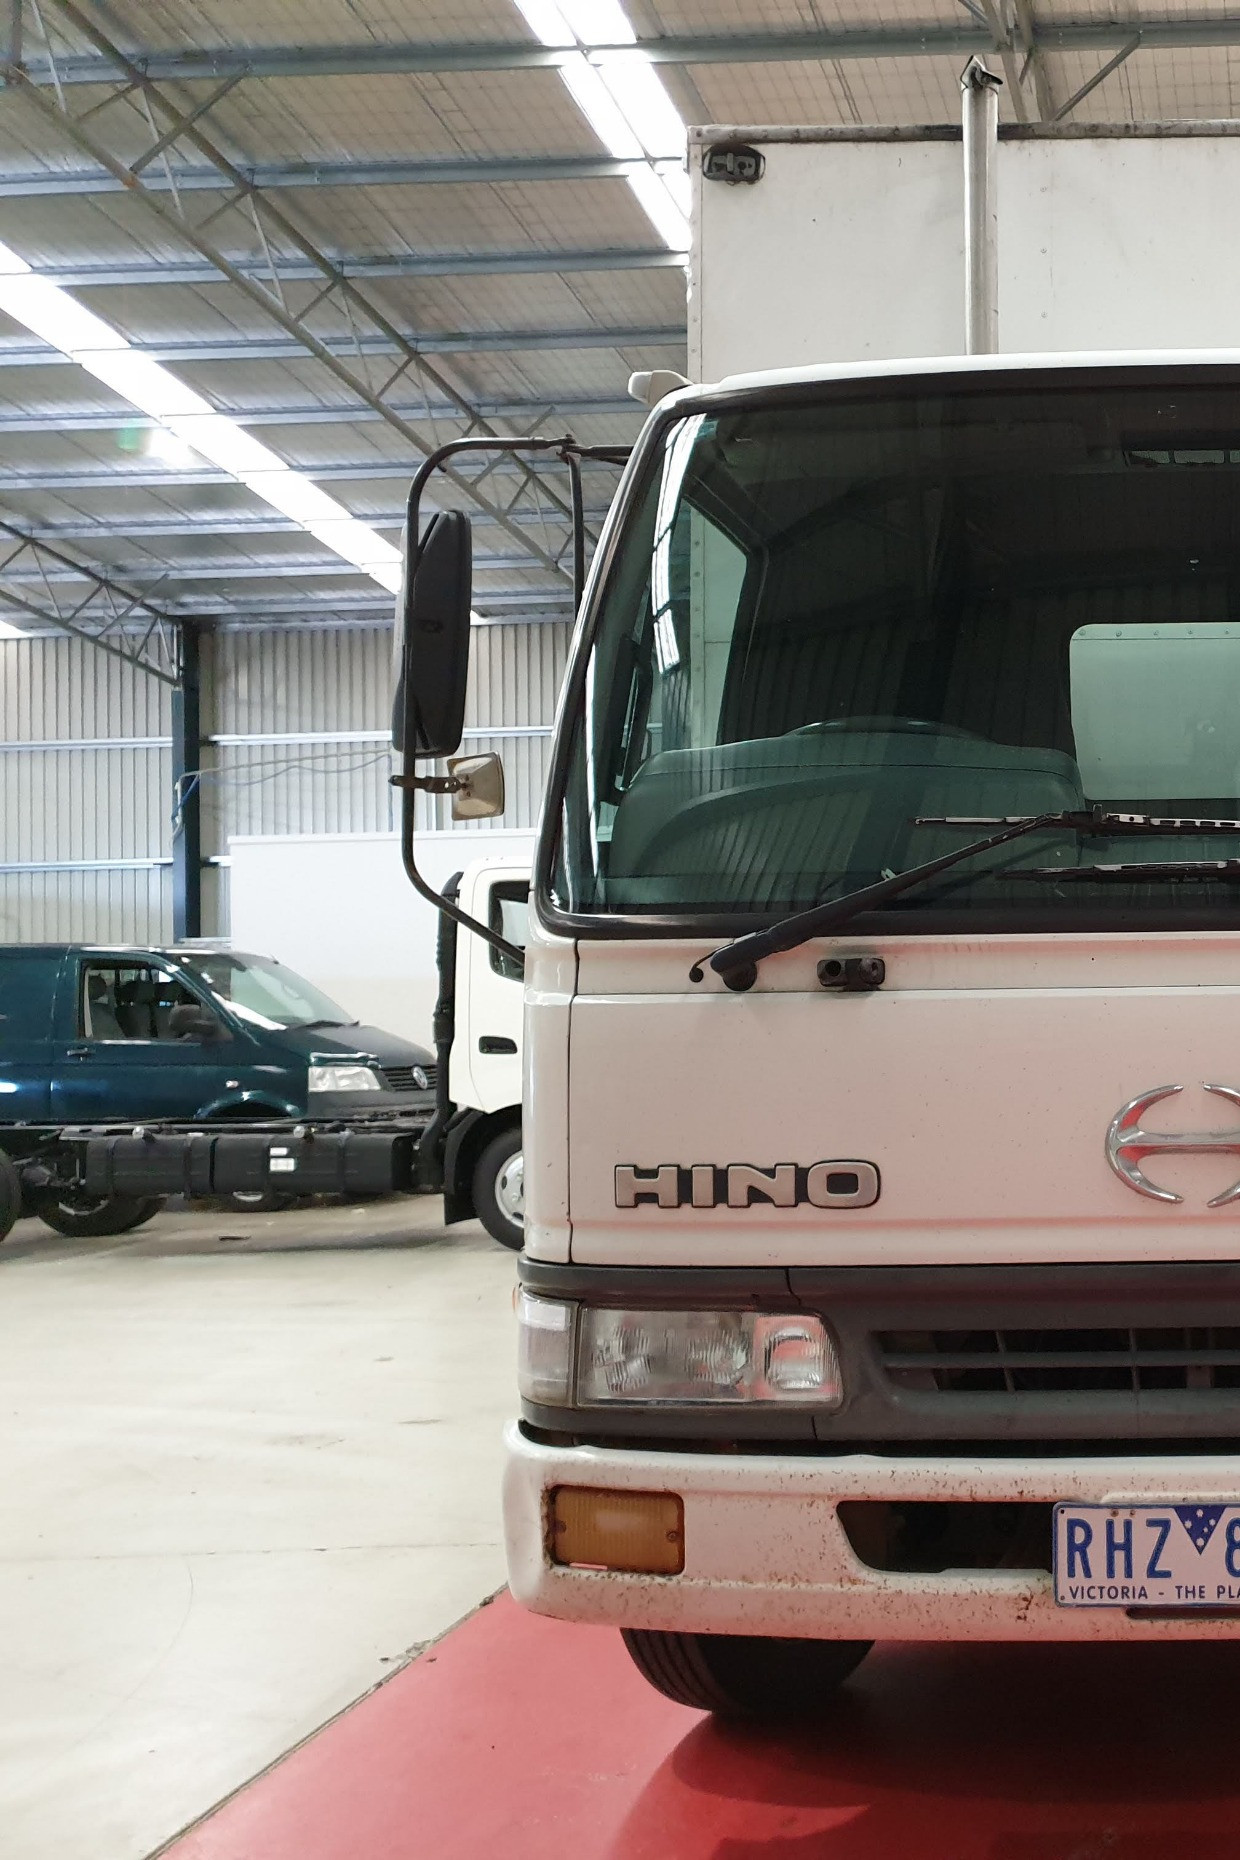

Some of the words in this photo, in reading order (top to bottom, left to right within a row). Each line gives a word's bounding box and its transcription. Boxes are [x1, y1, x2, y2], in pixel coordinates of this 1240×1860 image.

[614, 1158, 882, 1210] HINO
[1066, 1517, 1172, 1579] RHZ
[1069, 1585, 1148, 1600] VICTORIA
[1175, 1584, 1206, 1599] THE
